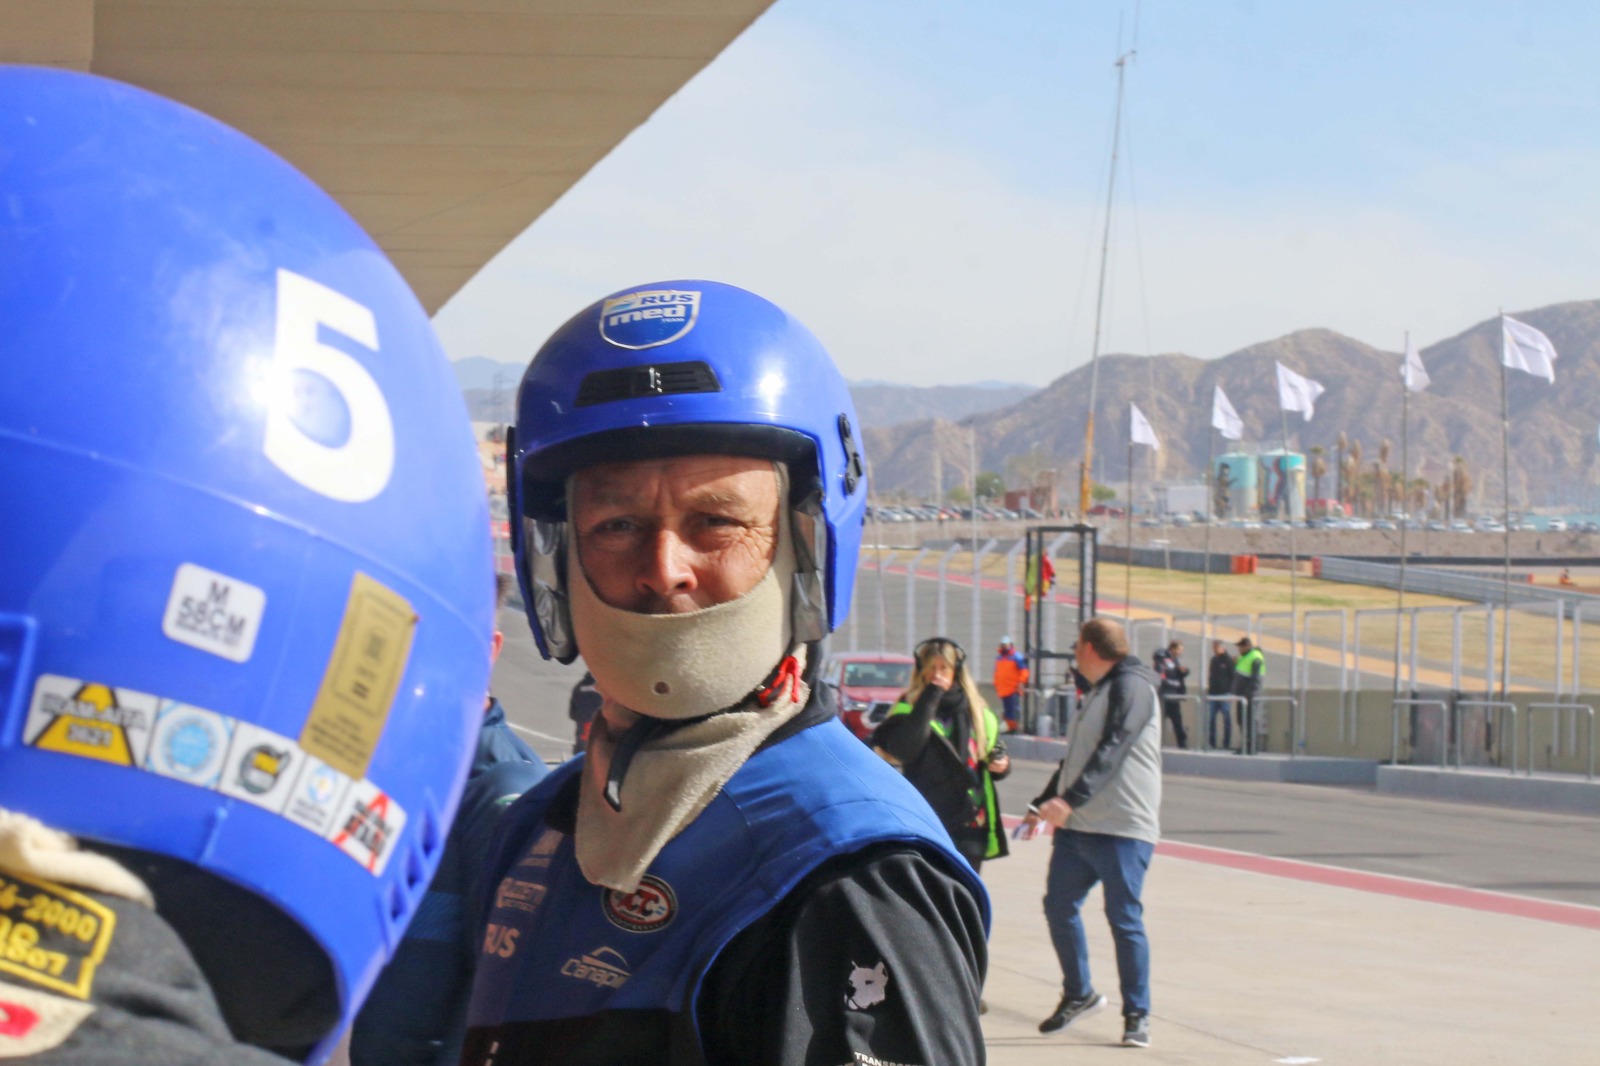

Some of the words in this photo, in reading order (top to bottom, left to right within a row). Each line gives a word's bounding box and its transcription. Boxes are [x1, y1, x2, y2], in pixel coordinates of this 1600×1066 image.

[641, 294, 694, 305] RUS
[609, 305, 686, 326] med
[263, 268, 395, 503] 5
[207, 580, 230, 607] M
